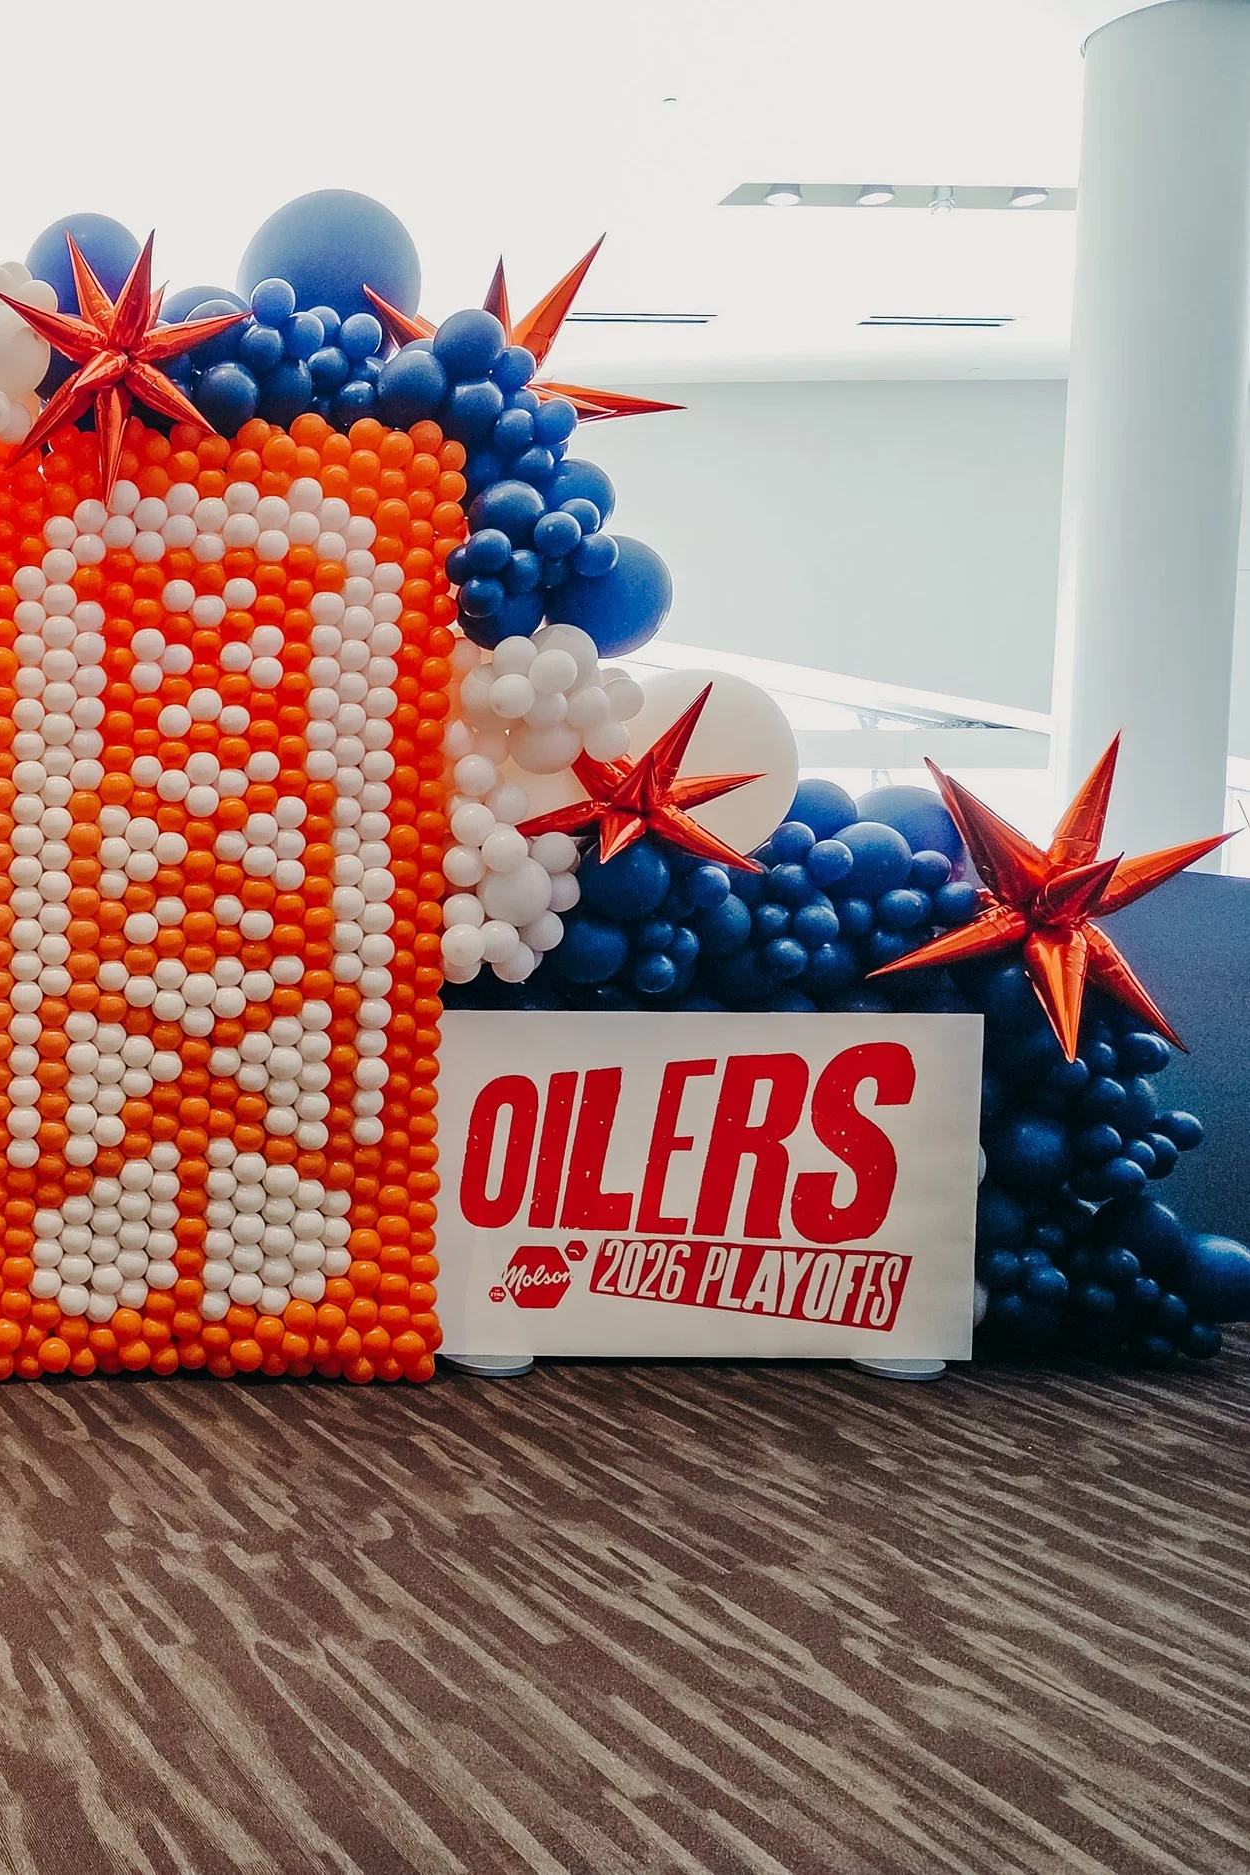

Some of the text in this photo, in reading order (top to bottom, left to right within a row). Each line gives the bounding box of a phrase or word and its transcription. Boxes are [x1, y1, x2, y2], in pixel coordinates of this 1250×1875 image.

[459, 1041, 916, 1244] OILERS
[503, 1264, 572, 1296] Molson
[596, 1240, 904, 1327] 2026 PLAYOFFS
